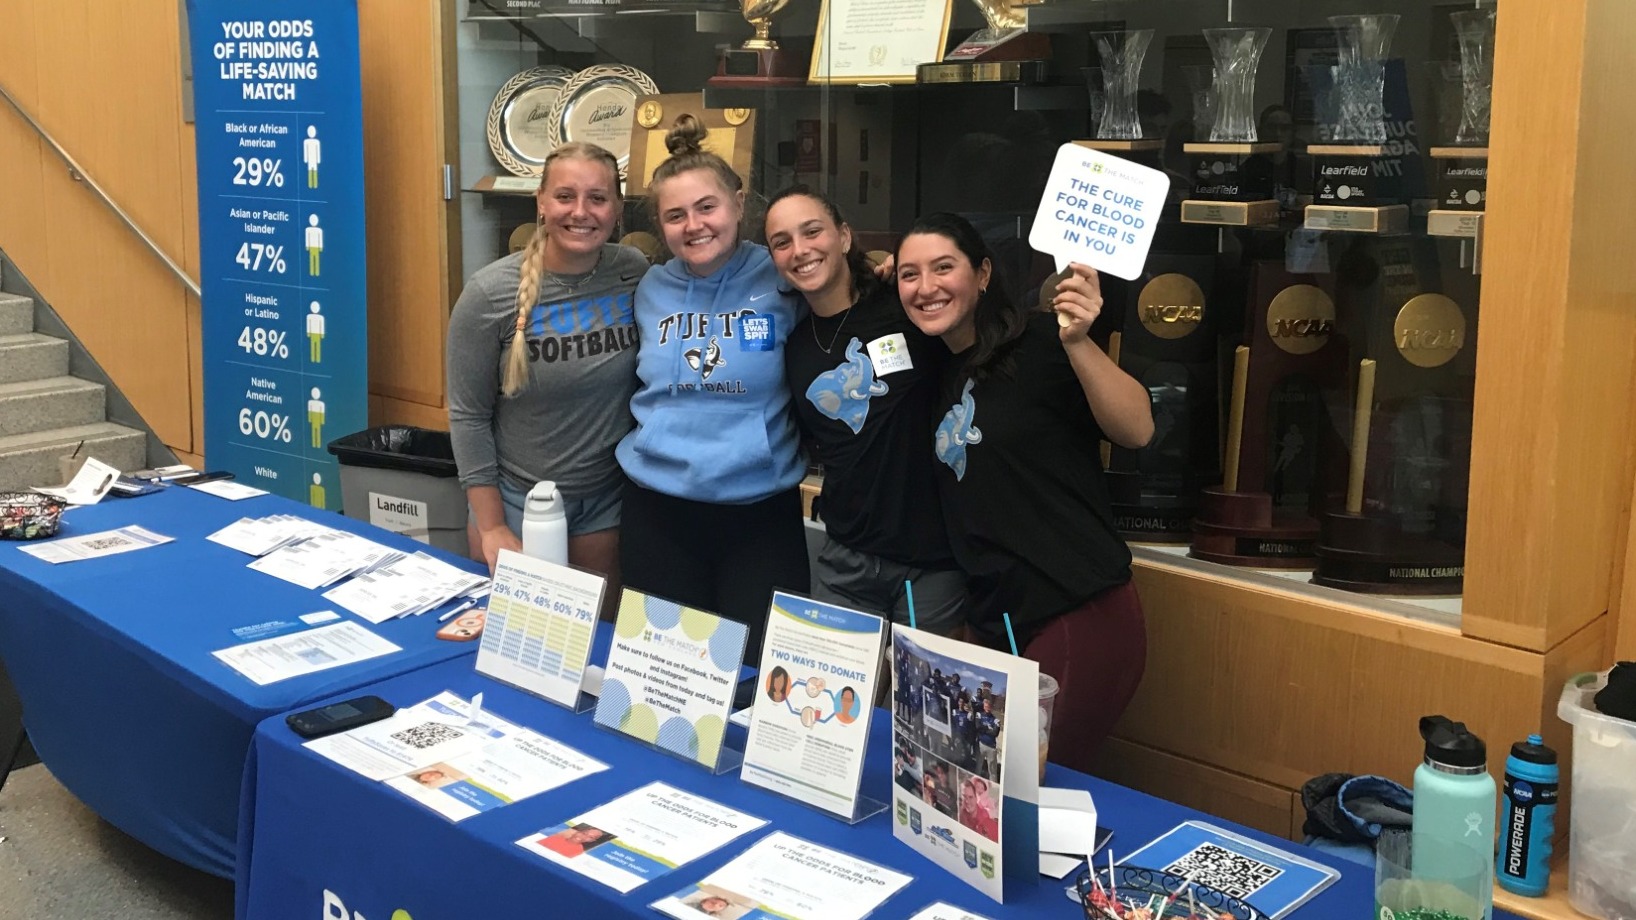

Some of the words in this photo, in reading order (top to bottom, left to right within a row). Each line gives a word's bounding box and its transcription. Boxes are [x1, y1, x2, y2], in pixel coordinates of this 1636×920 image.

[222, 21, 264, 38] YOUR
[269, 20, 313, 38] ODDS
[214, 42, 235, 59] OF
[239, 41, 303, 58] FINDING
[307, 42, 319, 58] A
[220, 62, 317, 80] LIFE-SAVING
[242, 83, 296, 100] MATCH
[528, 109, 551, 122] Awa
[588, 105, 627, 124] Award
[225, 123, 247, 133] Black
[259, 124, 288, 134] African
[239, 137, 276, 148] American
[233, 157, 284, 187] 29%
[1321, 165, 1368, 176] Learfield
[1070, 178, 1100, 196] THE
[1103, 190, 1144, 212] CURE
[230, 208, 250, 219] Asian
[252, 211, 261, 220] or
[263, 211, 289, 222] Pacific
[1056, 192, 1088, 211] FOR
[1092, 203, 1144, 229] BLOOD
[245, 223, 275, 234] Islander
[1055, 210, 1118, 238] CANCER
[1121, 231, 1135, 244] IS
[1063, 229, 1080, 243] IN
[1085, 236, 1116, 255] YOU
[235, 242, 287, 274] 47%
[245, 293, 278, 306] Hispanic
[245, 308, 253, 316] or
[255, 308, 279, 320] Latino
[532, 293, 634, 336] TUFTS
[743, 318, 768, 326] LET'S
[1272, 319, 1334, 338] NCAA
[237, 326, 289, 359] 48%
[744, 331, 768, 340] SPIT
[526, 326, 637, 363] SOFTBALL
[251, 377, 276, 390] Native
[246, 390, 282, 404] American
[239, 407, 292, 443] 60%
[255, 466, 277, 479] White
[377, 497, 418, 516] Landfill
[1389, 568, 1430, 578] NATIONAL
[494, 582, 511, 595] 29%
[514, 589, 530, 602] 47%
[534, 595, 550, 608] 48%
[553, 602, 572, 615] 60%
[575, 608, 593, 622] 79%
[617, 643, 630, 652] Make
[631, 648, 642, 656] sure
[650, 653, 665, 663] follow
[709, 673, 729, 686] Twitter
[649, 665, 659, 673] and
[771, 649, 790, 661] TWO
[792, 654, 816, 668] WAYS
[818, 661, 829, 672] TO
[830, 665, 866, 683] DONATE
[612, 662, 623, 671] Post
[624, 666, 642, 678] photos
[647, 674, 665, 685] videos
[666, 680, 678, 690] from
[679, 686, 694, 697] today
[695, 691, 705, 700] and
[707, 695, 715, 705] tag
[1513, 788, 1532, 799] NCAA
[710, 815, 738, 829] BLOOD
[1509, 806, 1526, 875] POWERADE
[851, 870, 886, 886] BLOOD
